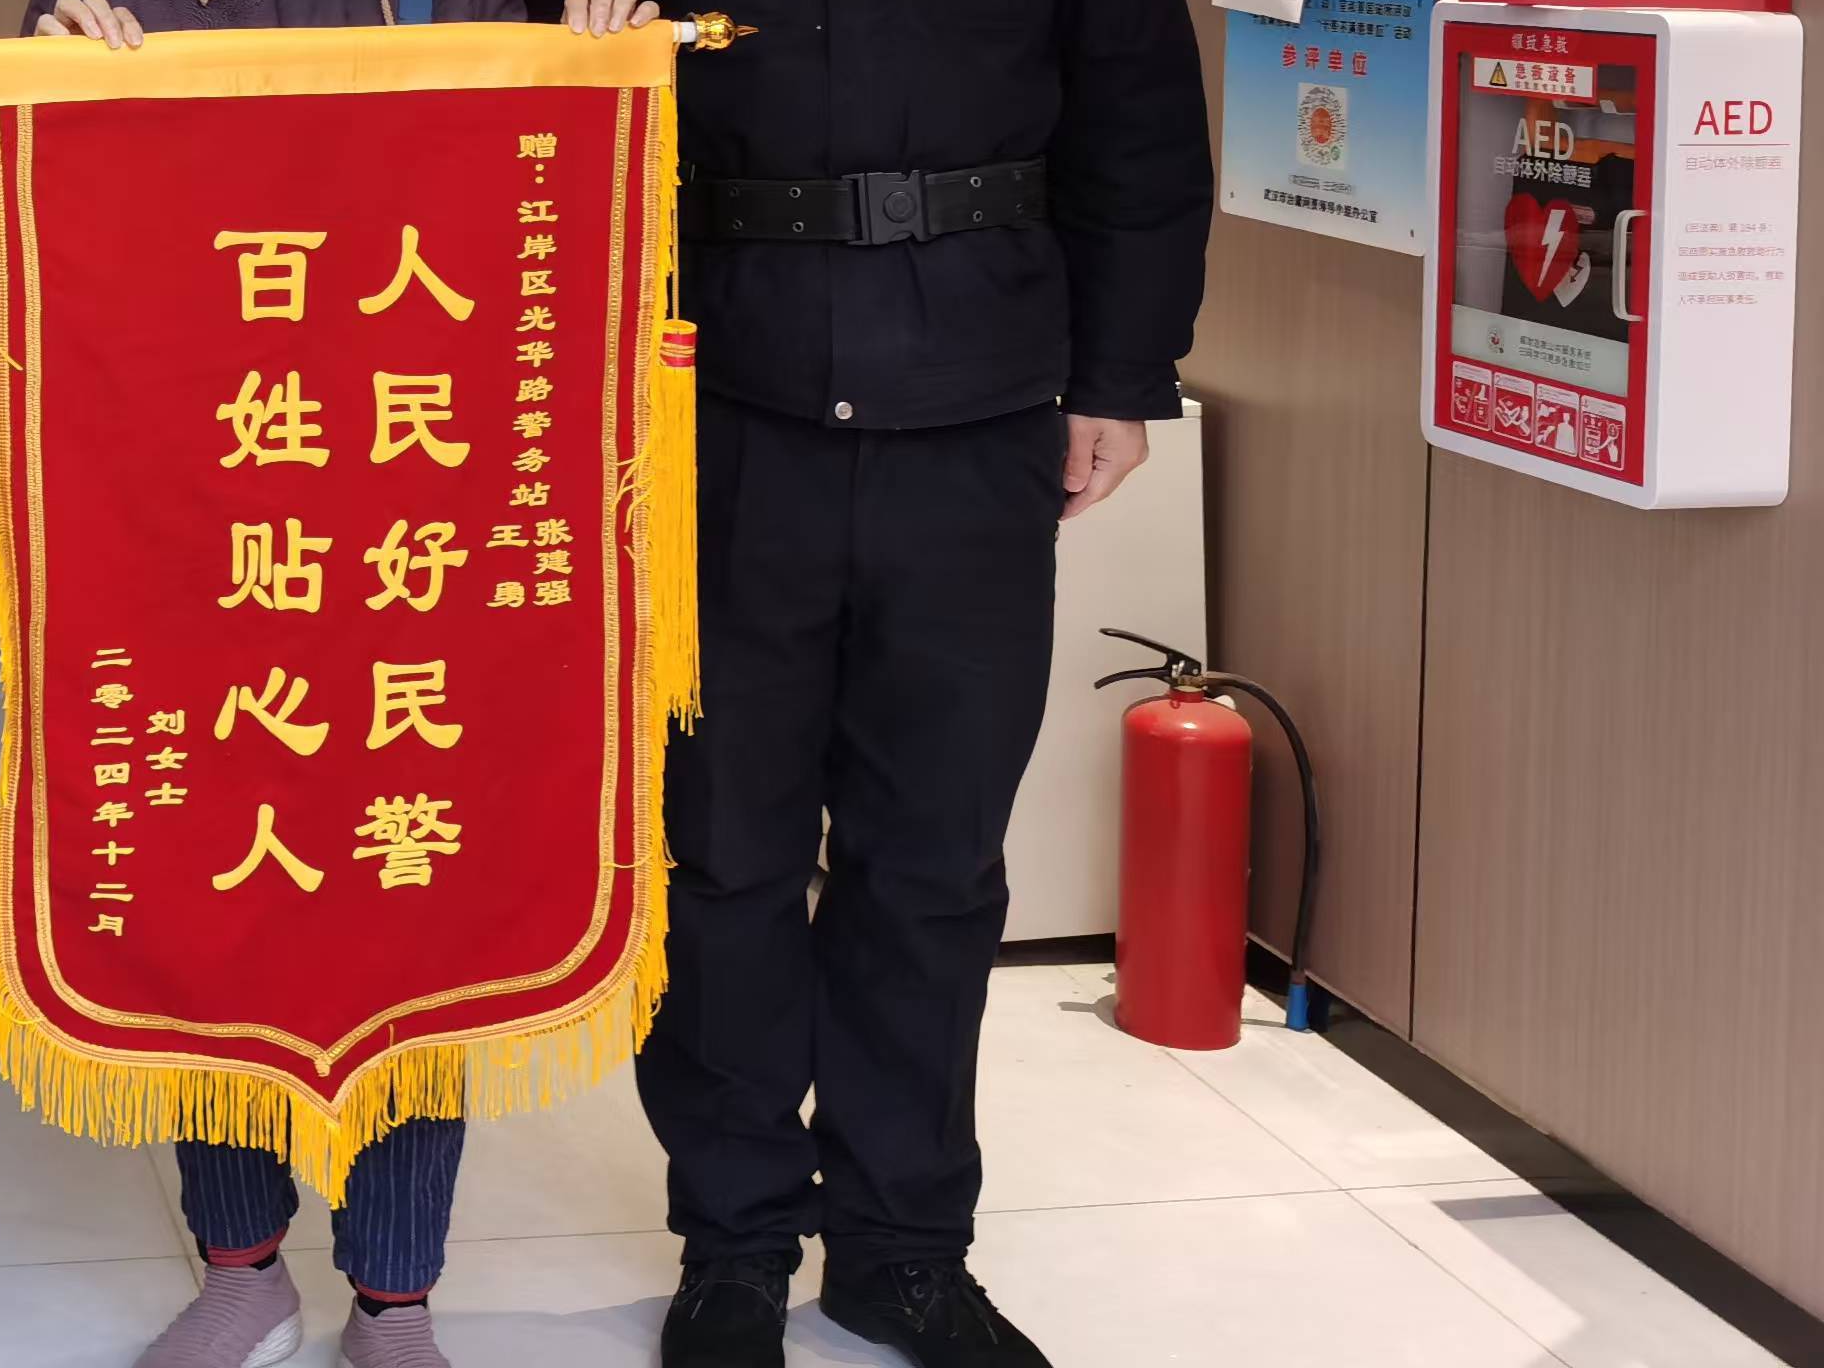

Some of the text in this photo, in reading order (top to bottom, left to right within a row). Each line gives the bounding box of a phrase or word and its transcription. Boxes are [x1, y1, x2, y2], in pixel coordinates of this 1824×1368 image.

[1511, 117, 1575, 161] AED
[1693, 100, 1774, 136] AED
[1494, 155, 1593, 189] 自动体外除颤器
[211, 228, 334, 893] 百姓贴心人
[352, 223, 477, 891] 人民好民警
[485, 524, 530, 608] 王勇
[532, 518, 574, 607] 张建强
[87, 647, 135, 937] 二零二四年十二月
[144, 708, 189, 807] 刘女士
